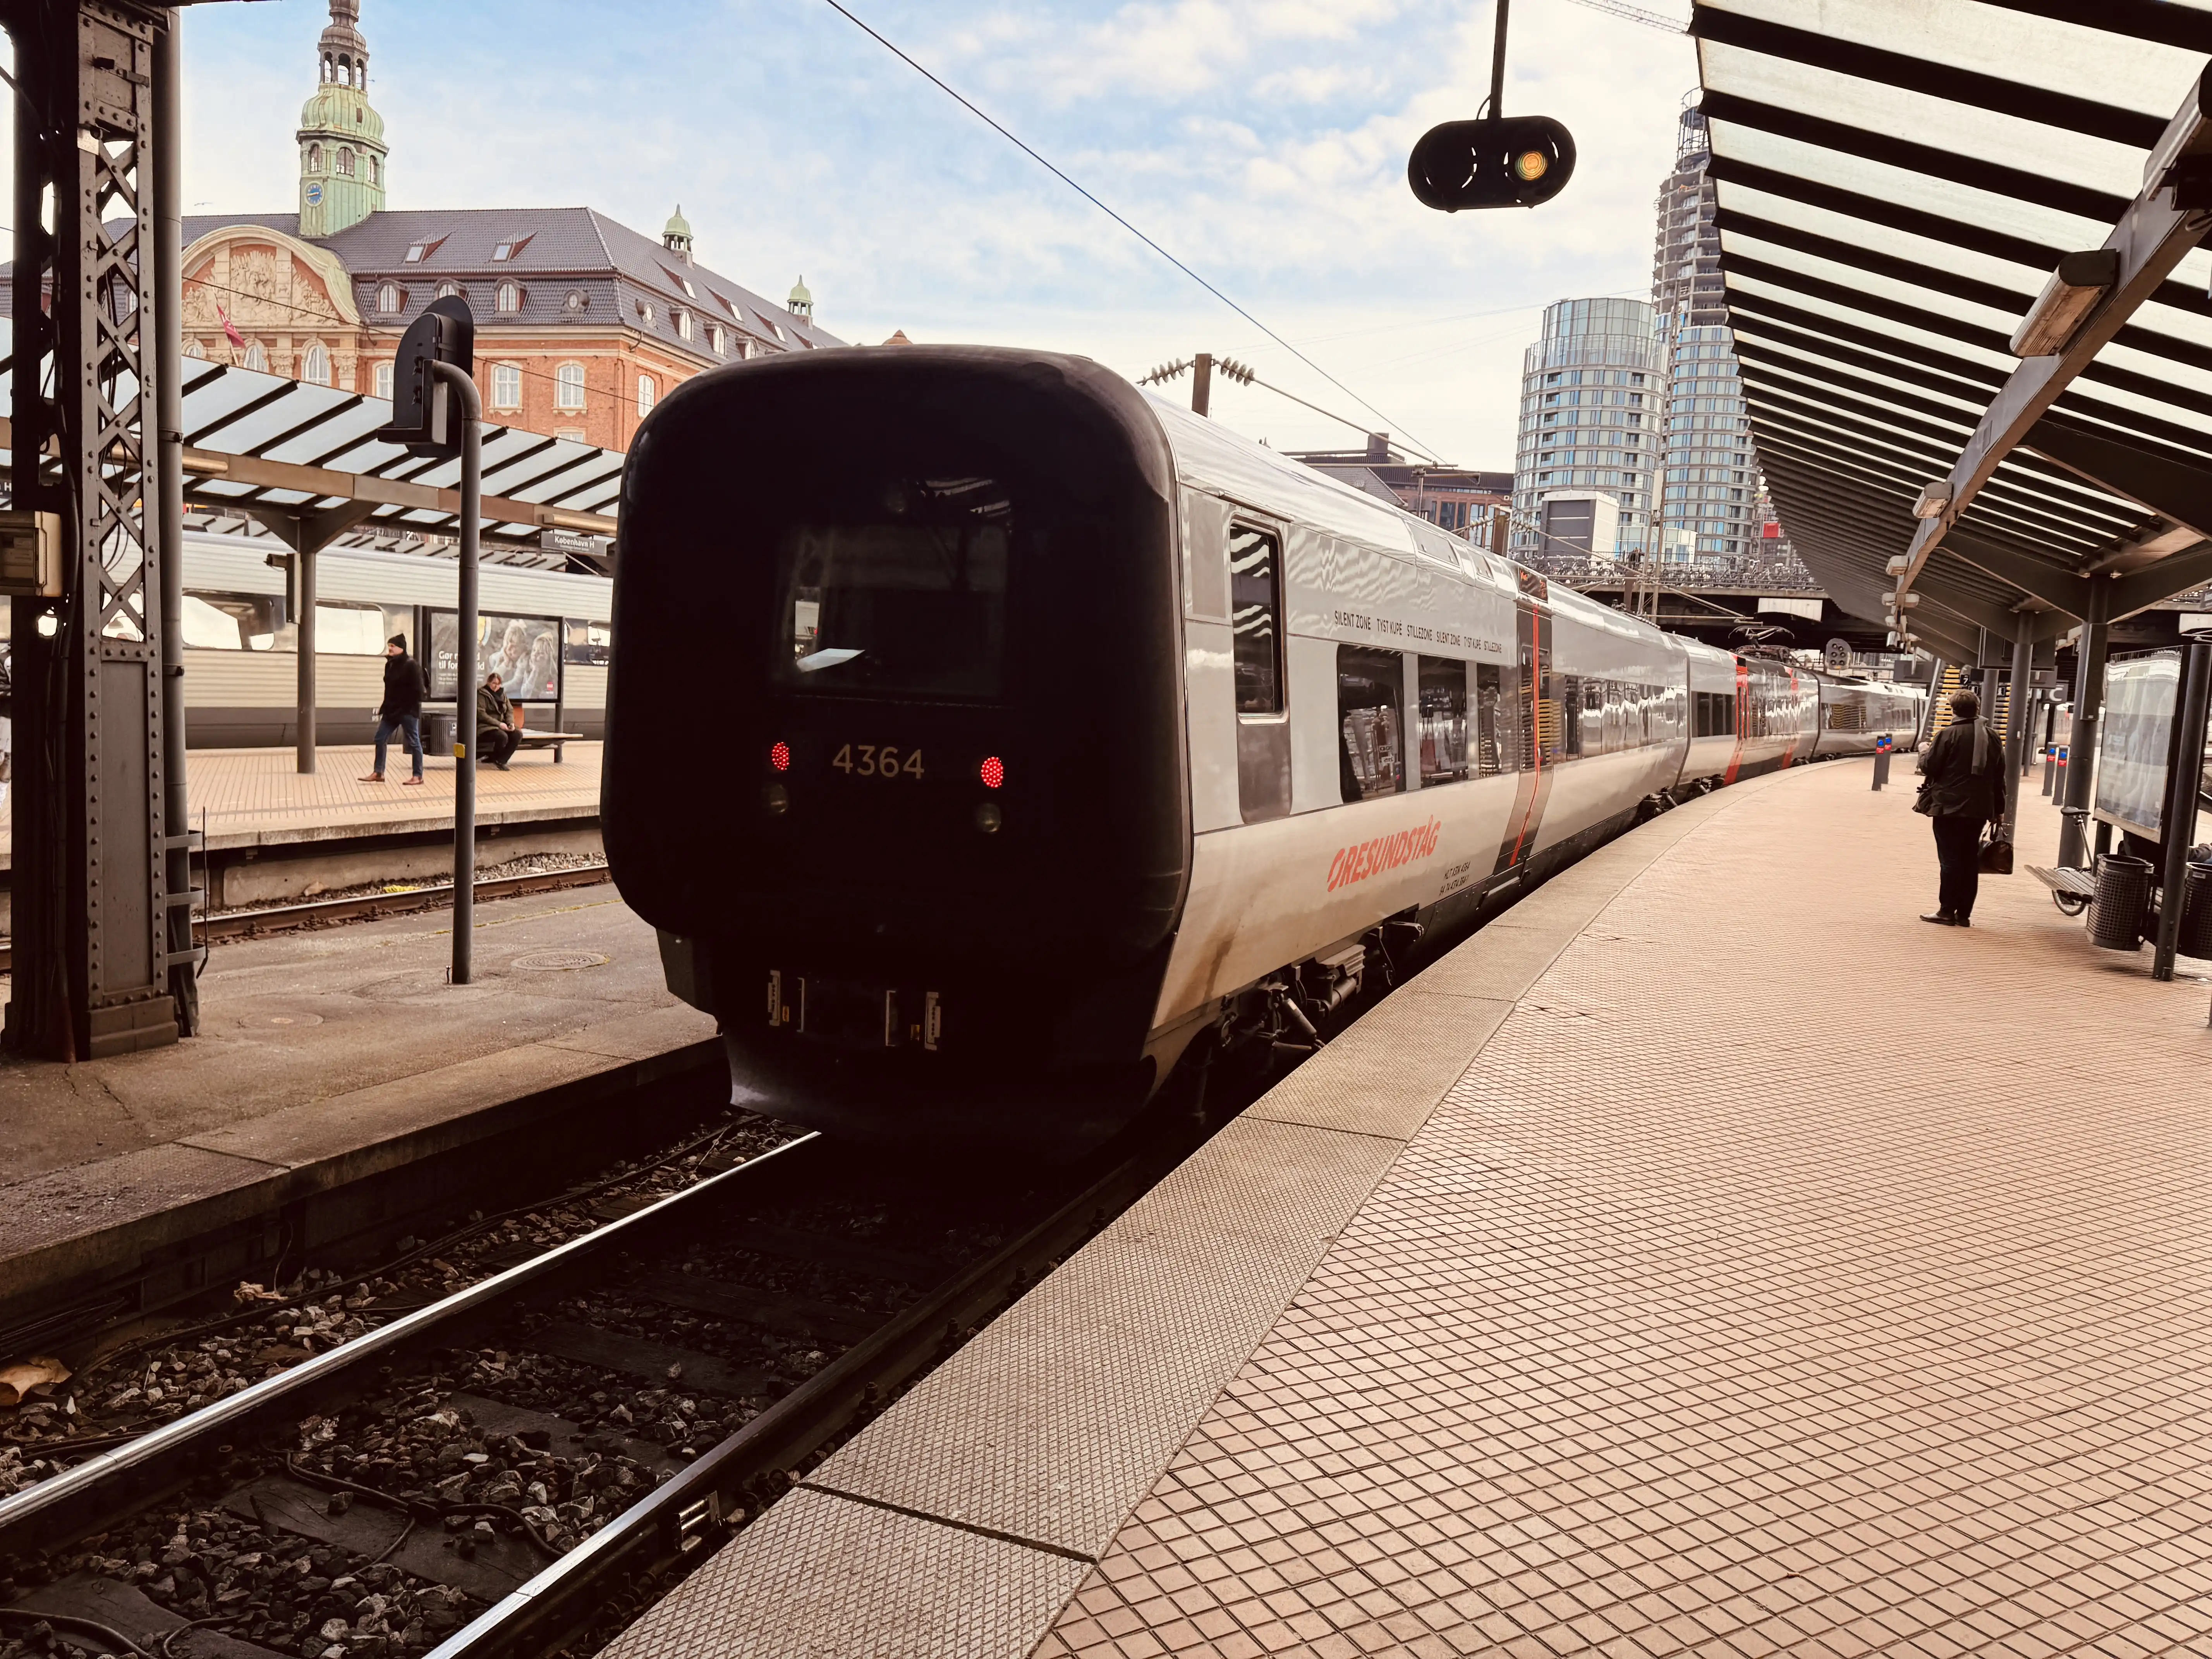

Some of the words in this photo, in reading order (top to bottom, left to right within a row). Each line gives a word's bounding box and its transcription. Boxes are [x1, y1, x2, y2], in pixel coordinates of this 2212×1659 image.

[555, 535, 588, 548] København
[1334, 610, 1354, 627] SILENT
[1356, 615, 1371, 630] ZONE
[1377, 618, 1388, 633] TYST
[1390, 620, 1402, 635] KUPÉ
[1407, 625, 1432, 641] STILLEZONE
[1437, 631, 1449, 644] SILENT
[1450, 634, 1460, 646] ZONE
[1464, 636, 1472, 648] TYST
[1472, 637, 1481, 650] KUPÉ
[1484, 641, 1502, 653] STILLEZONE
[438, 651, 453, 660] Gør
[2049, 687, 2063, 702] C
[832, 744, 925, 780] 4364
[1327, 814, 1441, 892] ØRESUNDSTÅG
